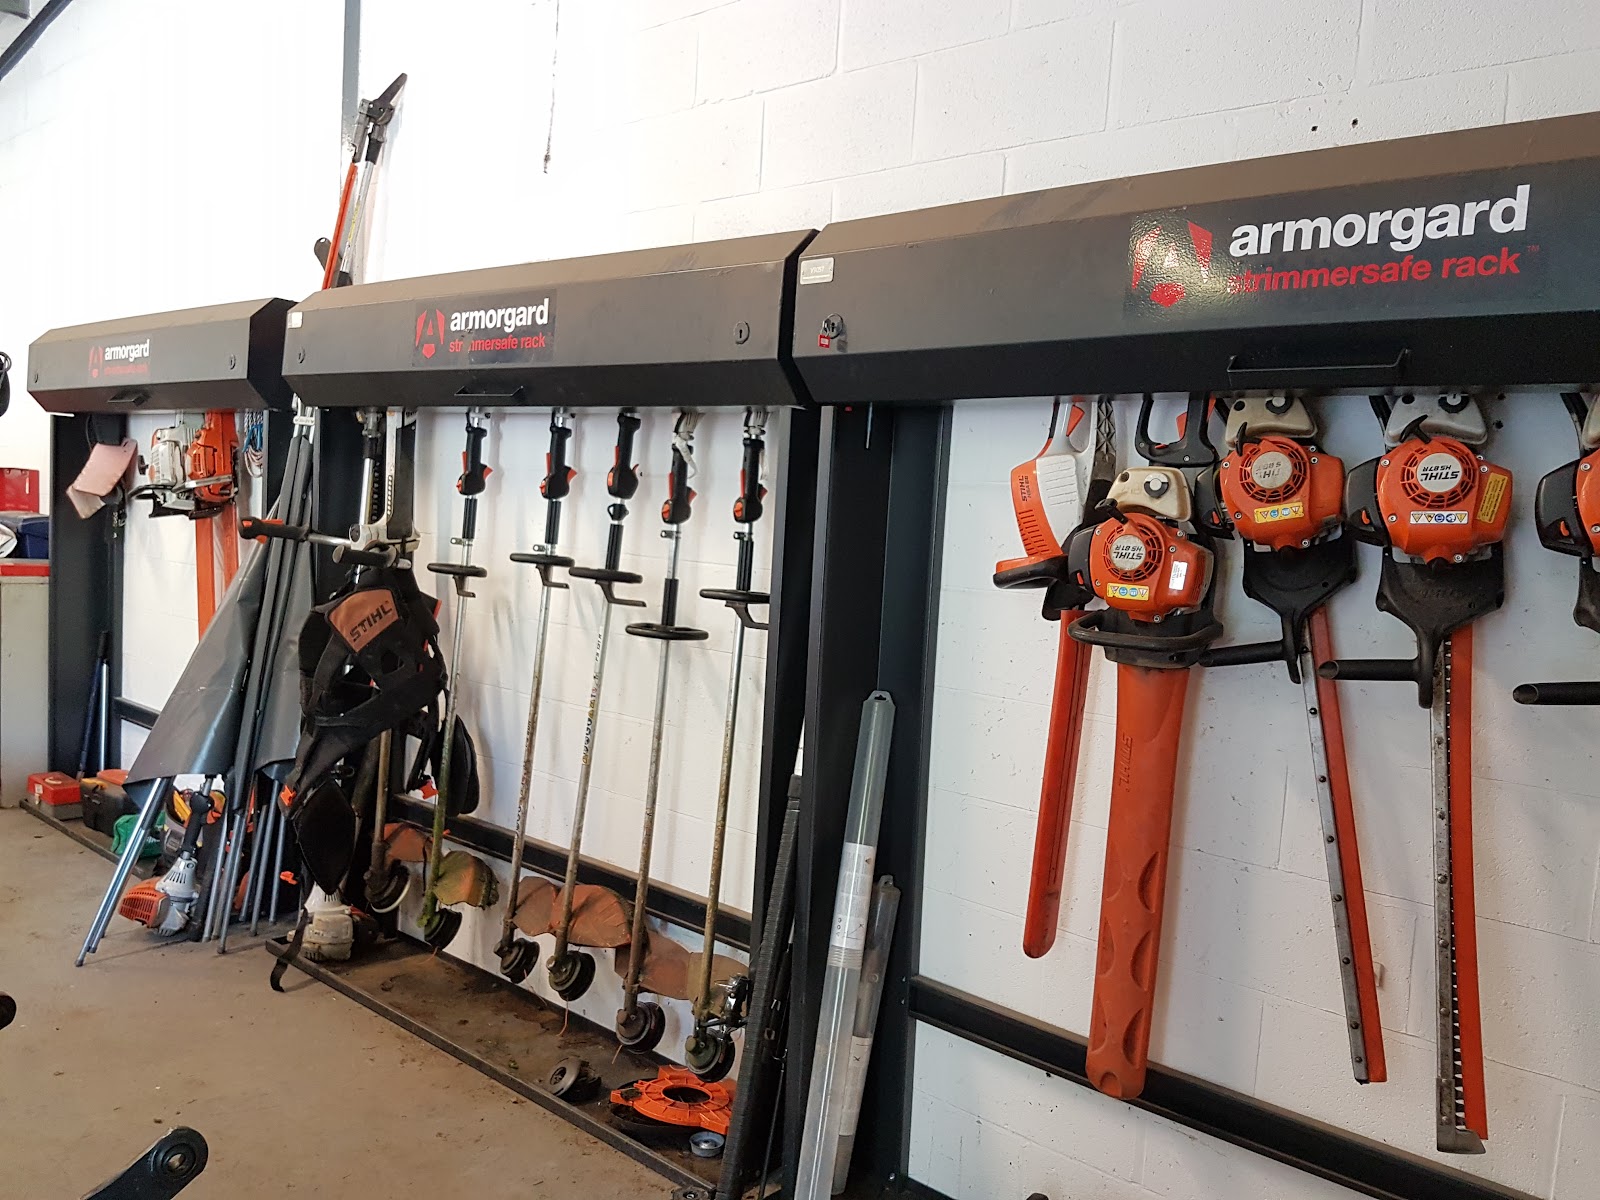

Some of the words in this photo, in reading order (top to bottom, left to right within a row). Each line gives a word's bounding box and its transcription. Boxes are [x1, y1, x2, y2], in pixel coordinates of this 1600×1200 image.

[1229, 184, 1532, 256] armorgard
[1227, 255, 1431, 295] strimmersafe
[1441, 247, 1521, 279] rack
[449, 297, 550, 333] armorgard
[104, 338, 150, 362] armorgard
[520, 332, 545, 349] rack
[1018, 475, 1028, 502] STIHL
[1421, 470, 1460, 481] STIHL
[1113, 551, 1144, 560] STIHL
[350, 604, 393, 642] STIHL
